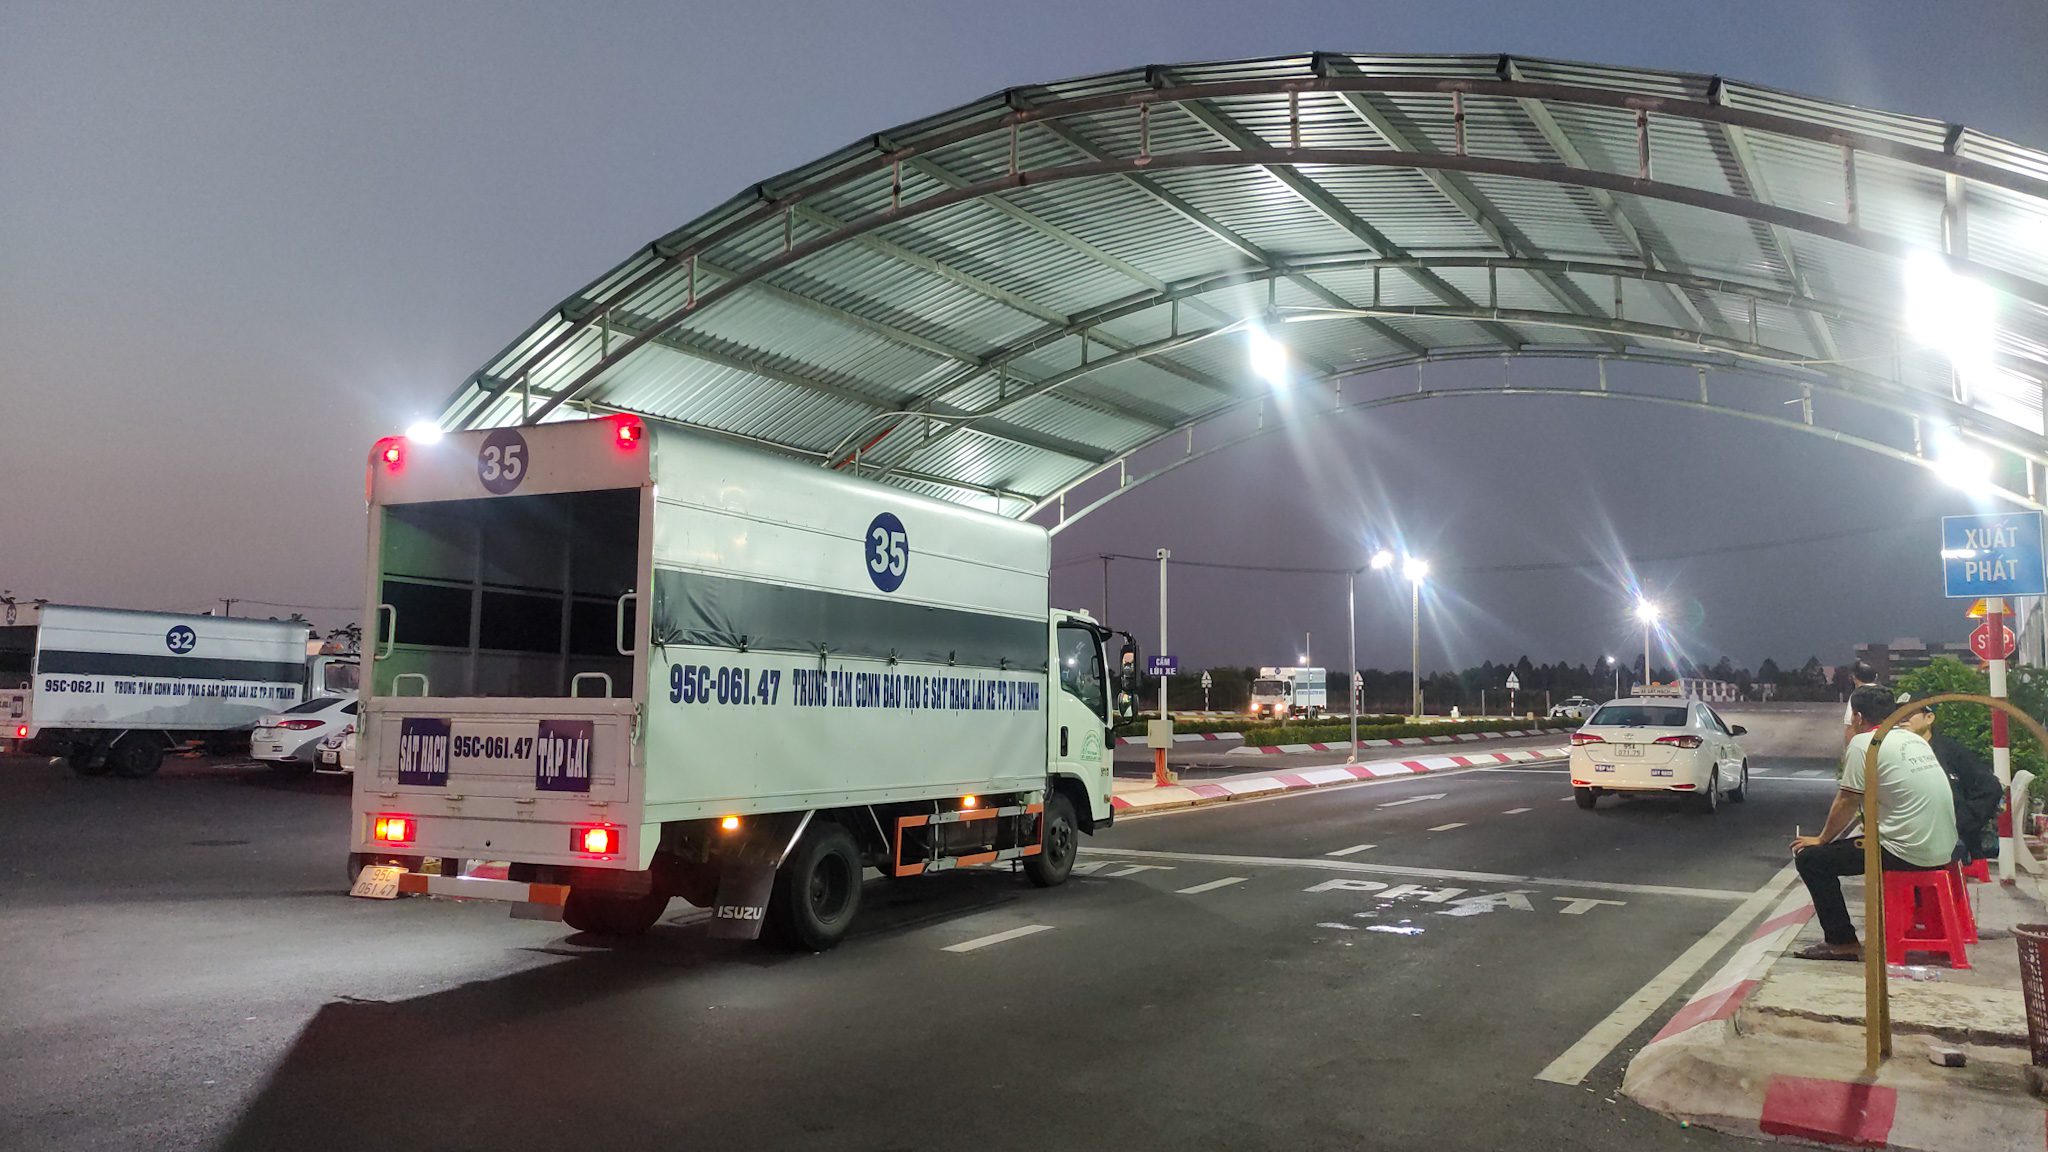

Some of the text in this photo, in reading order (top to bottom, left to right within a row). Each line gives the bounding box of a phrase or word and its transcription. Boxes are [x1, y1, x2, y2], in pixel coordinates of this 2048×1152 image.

[482, 445, 521, 480] 35
[1965, 519, 2018, 549] XUẤT
[871, 527, 905, 576] 35
[1965, 554, 2018, 582] PHÁT
[169, 632, 194, 649] 32
[1978, 634, 2010, 649] SP
[1165, 667, 1177, 675] XE
[45, 679, 105, 694] 95C-062.11
[114, 681, 137, 695] TRUNG
[139, 679, 153, 695] TÂM
[154, 682, 171, 696] GDNN
[187, 683, 200, 699] TẠO
[207, 682, 220, 697] SÁT
[221, 684, 238, 701] HẠCH
[238, 683, 249, 698] LÁI
[250, 686, 258, 699] XE
[276, 687, 296, 700] THANH
[669, 663, 781, 706] 95C-061.47
[793, 668, 828, 707] TRUNG
[831, 664, 853, 707] TÂM
[855, 672, 881, 708] GDNN
[883, 667, 901, 709] ĐÀO
[904, 674, 921, 715] TẠO
[931, 670, 948, 710] SÁT
[950, 678, 970, 716] HẠCH
[972, 673, 985, 711] LÁI
[986, 680, 996, 711] XE
[1017, 681, 1040, 711] THANH
[400, 727, 447, 781] SÁT HẠCH
[453, 735, 534, 760] 95C-061.47
[538, 730, 590, 785] TẬP LÁI
[372, 869, 395, 882] 95C
[357, 882, 395, 897] 061.47
[717, 905, 763, 920] ISUZU
